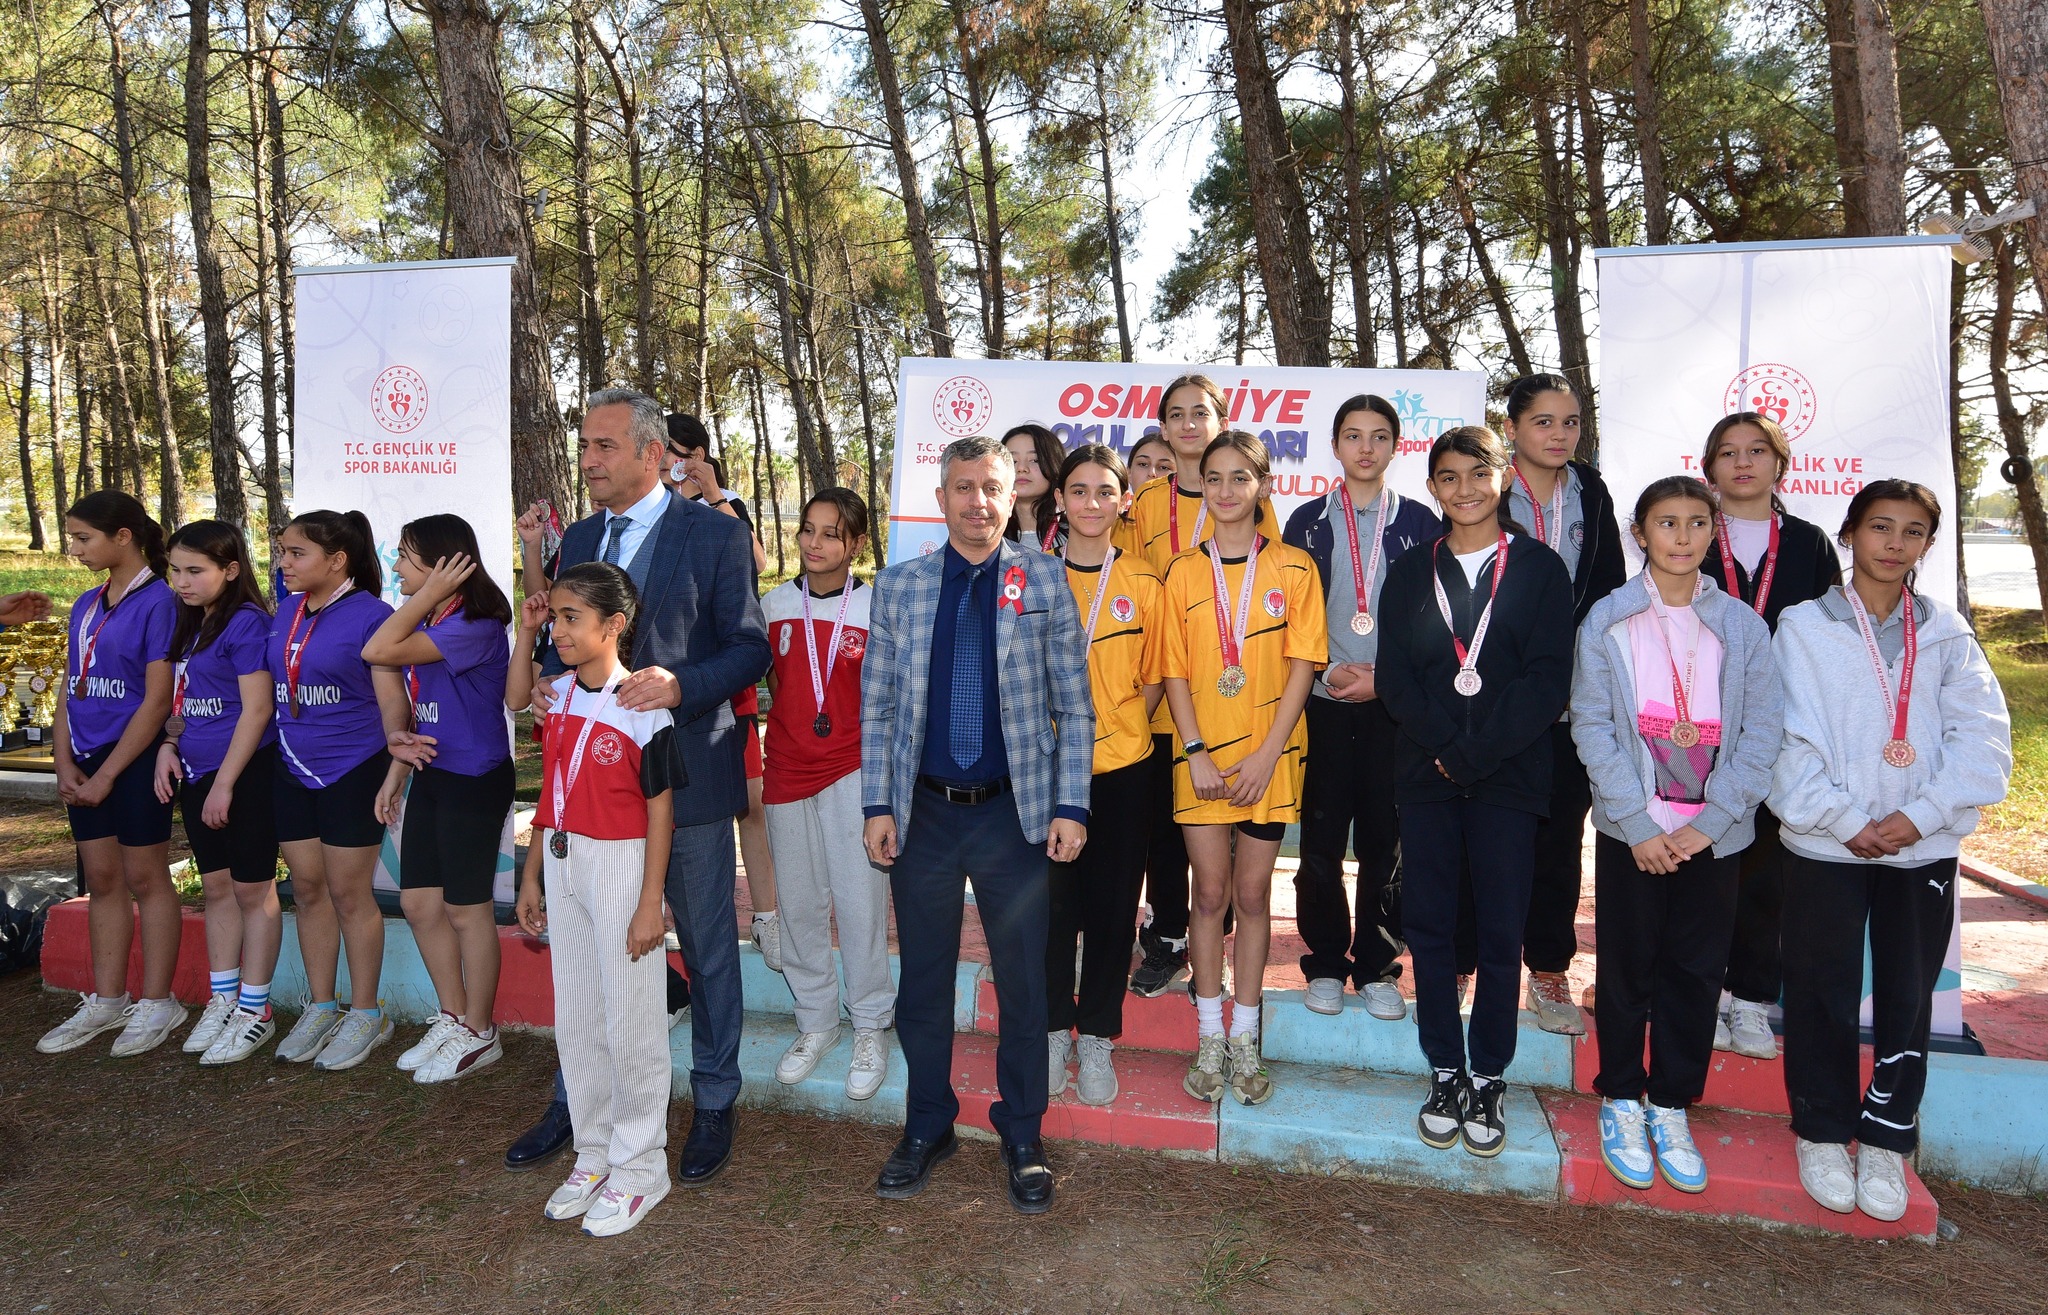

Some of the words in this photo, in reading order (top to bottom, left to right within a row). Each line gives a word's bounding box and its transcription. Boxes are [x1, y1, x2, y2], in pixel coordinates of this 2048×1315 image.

[1058, 379, 1311, 424] OSMİYE
[344, 443, 368, 455] T.C.
[373, 440, 433, 458] GENÇLİK
[439, 443, 456, 455] VE
[917, 443, 936, 452] T.C.
[344, 461, 379, 473] SPOR
[383, 458, 457, 474] BAKANLIĞI
[1834, 458, 1863, 473] VE
[1775, 477, 1864, 495] KANLIĞI
[779, 622, 793, 657] 8
